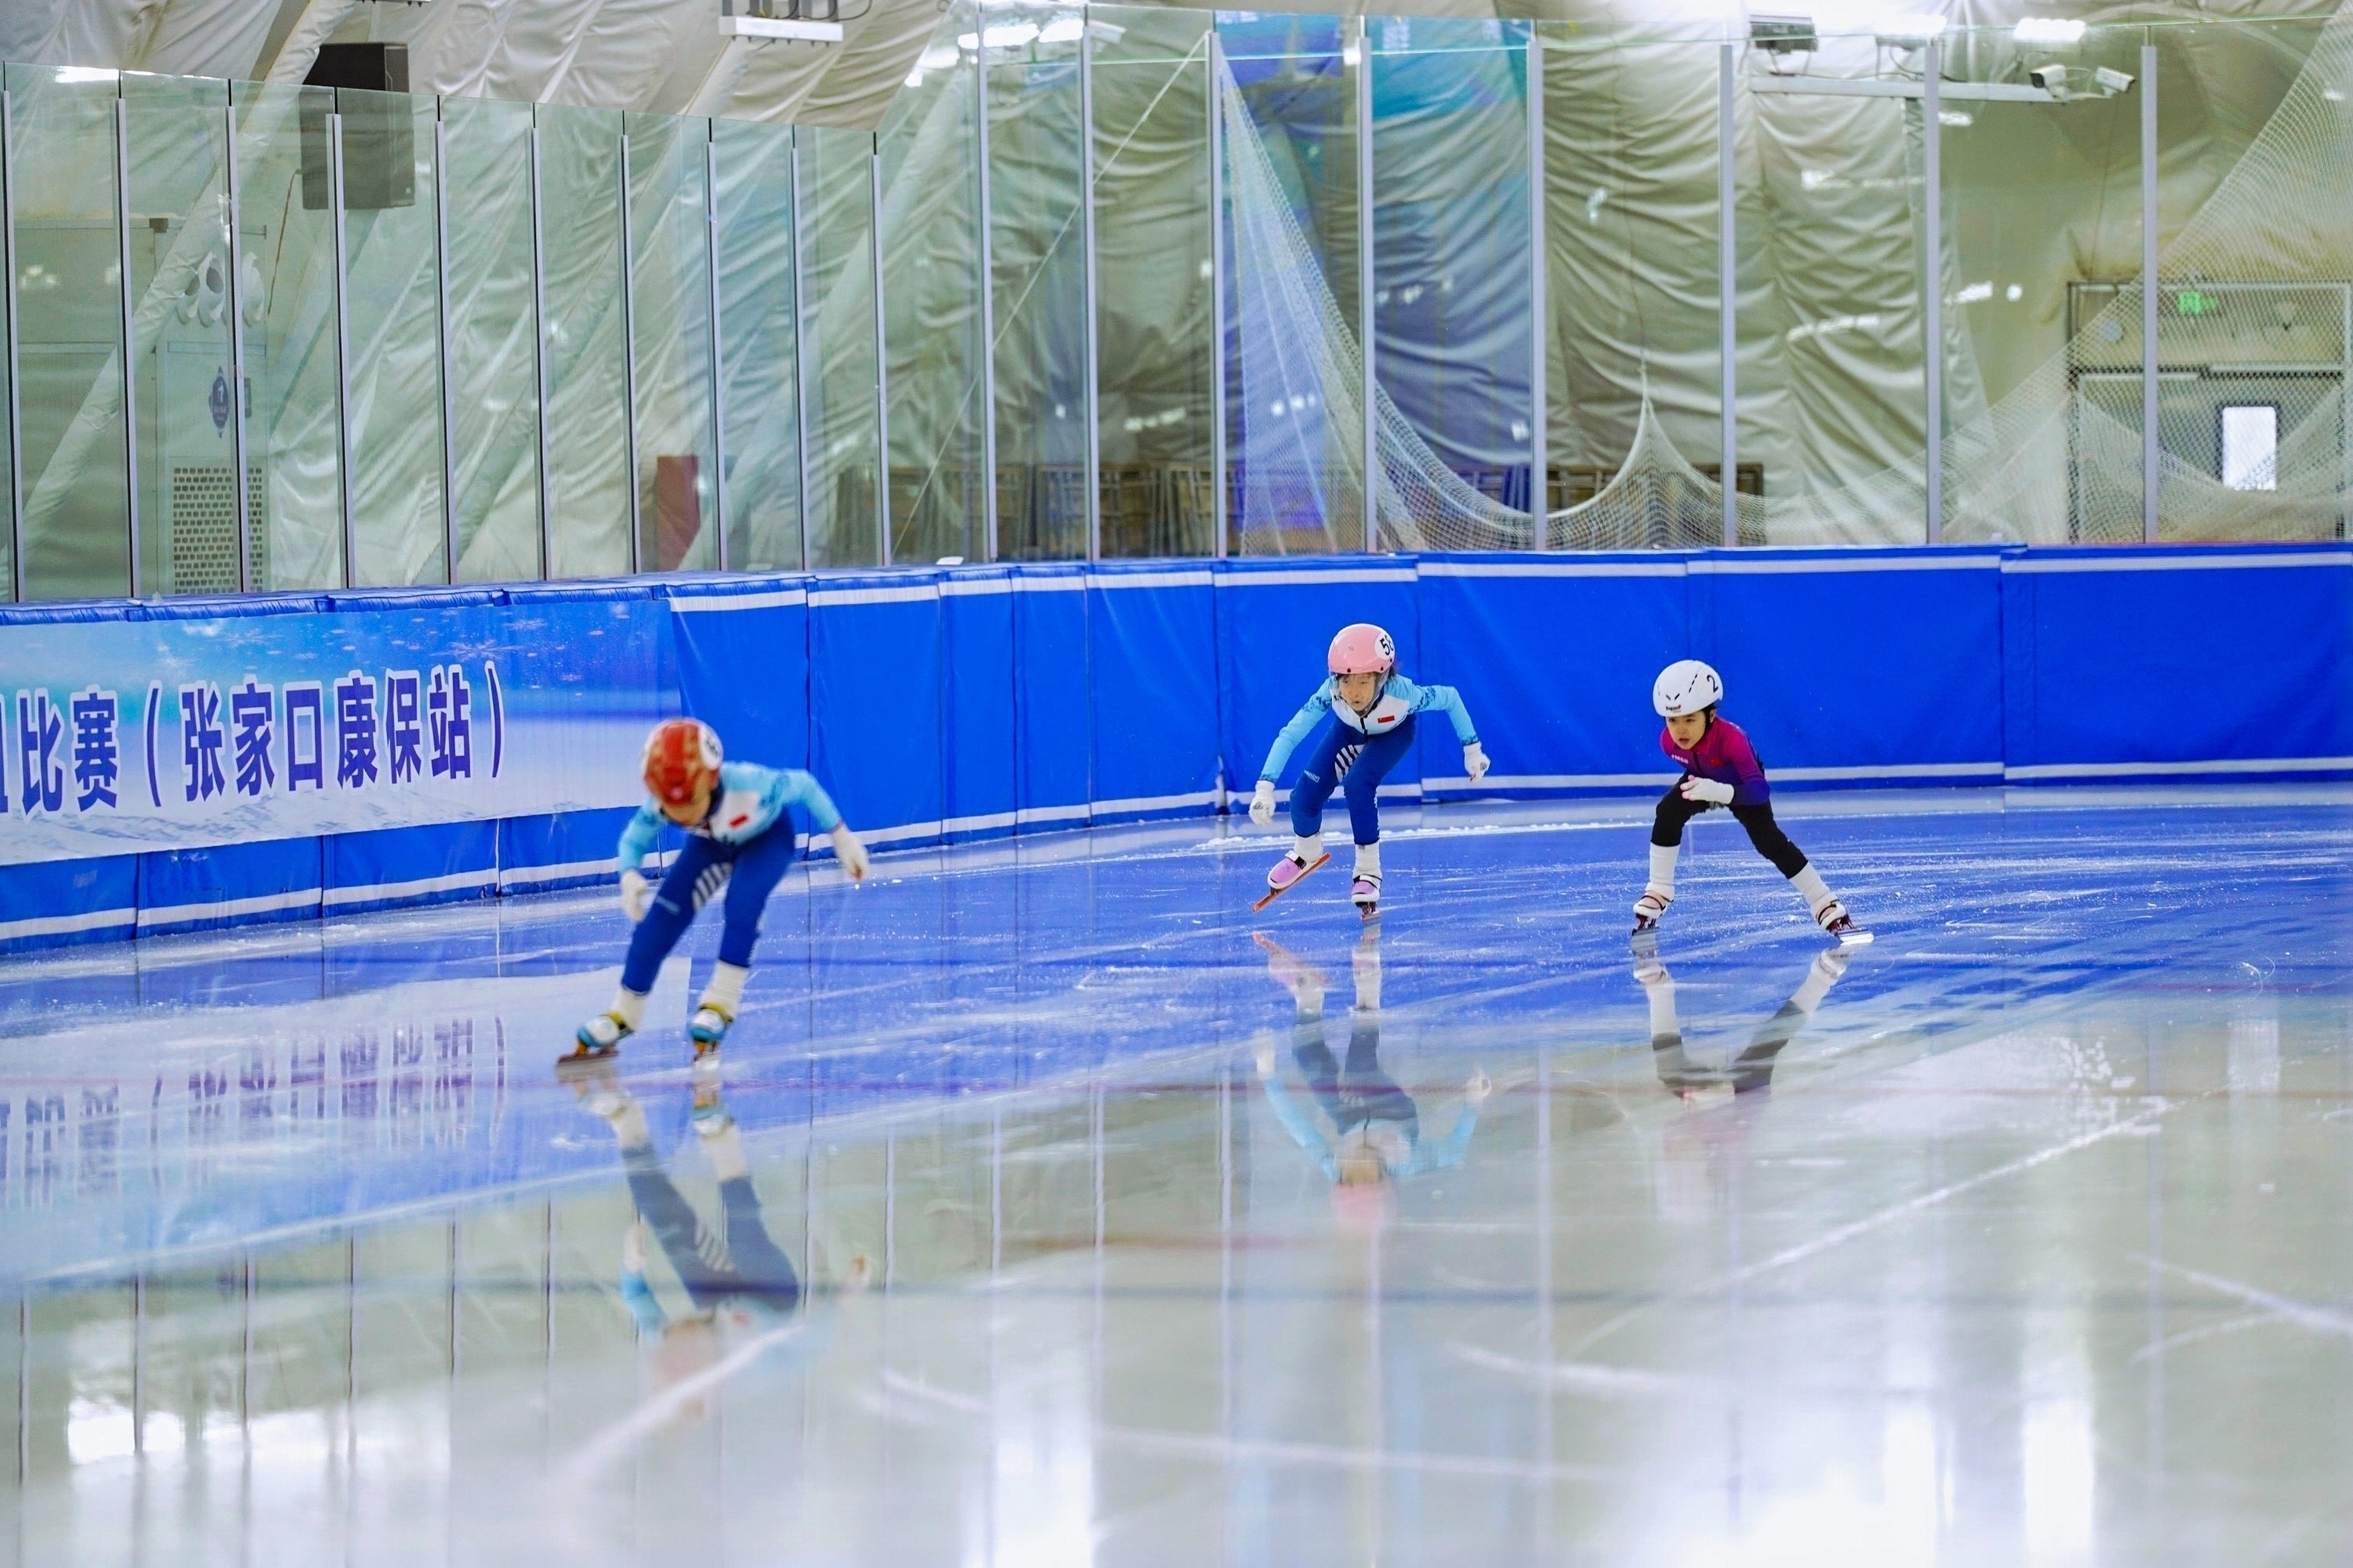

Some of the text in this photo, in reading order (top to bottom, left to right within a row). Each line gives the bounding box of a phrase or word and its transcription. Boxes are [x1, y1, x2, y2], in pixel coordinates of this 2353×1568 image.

[0, 662, 502, 815] 比赛（张家口康保站）
